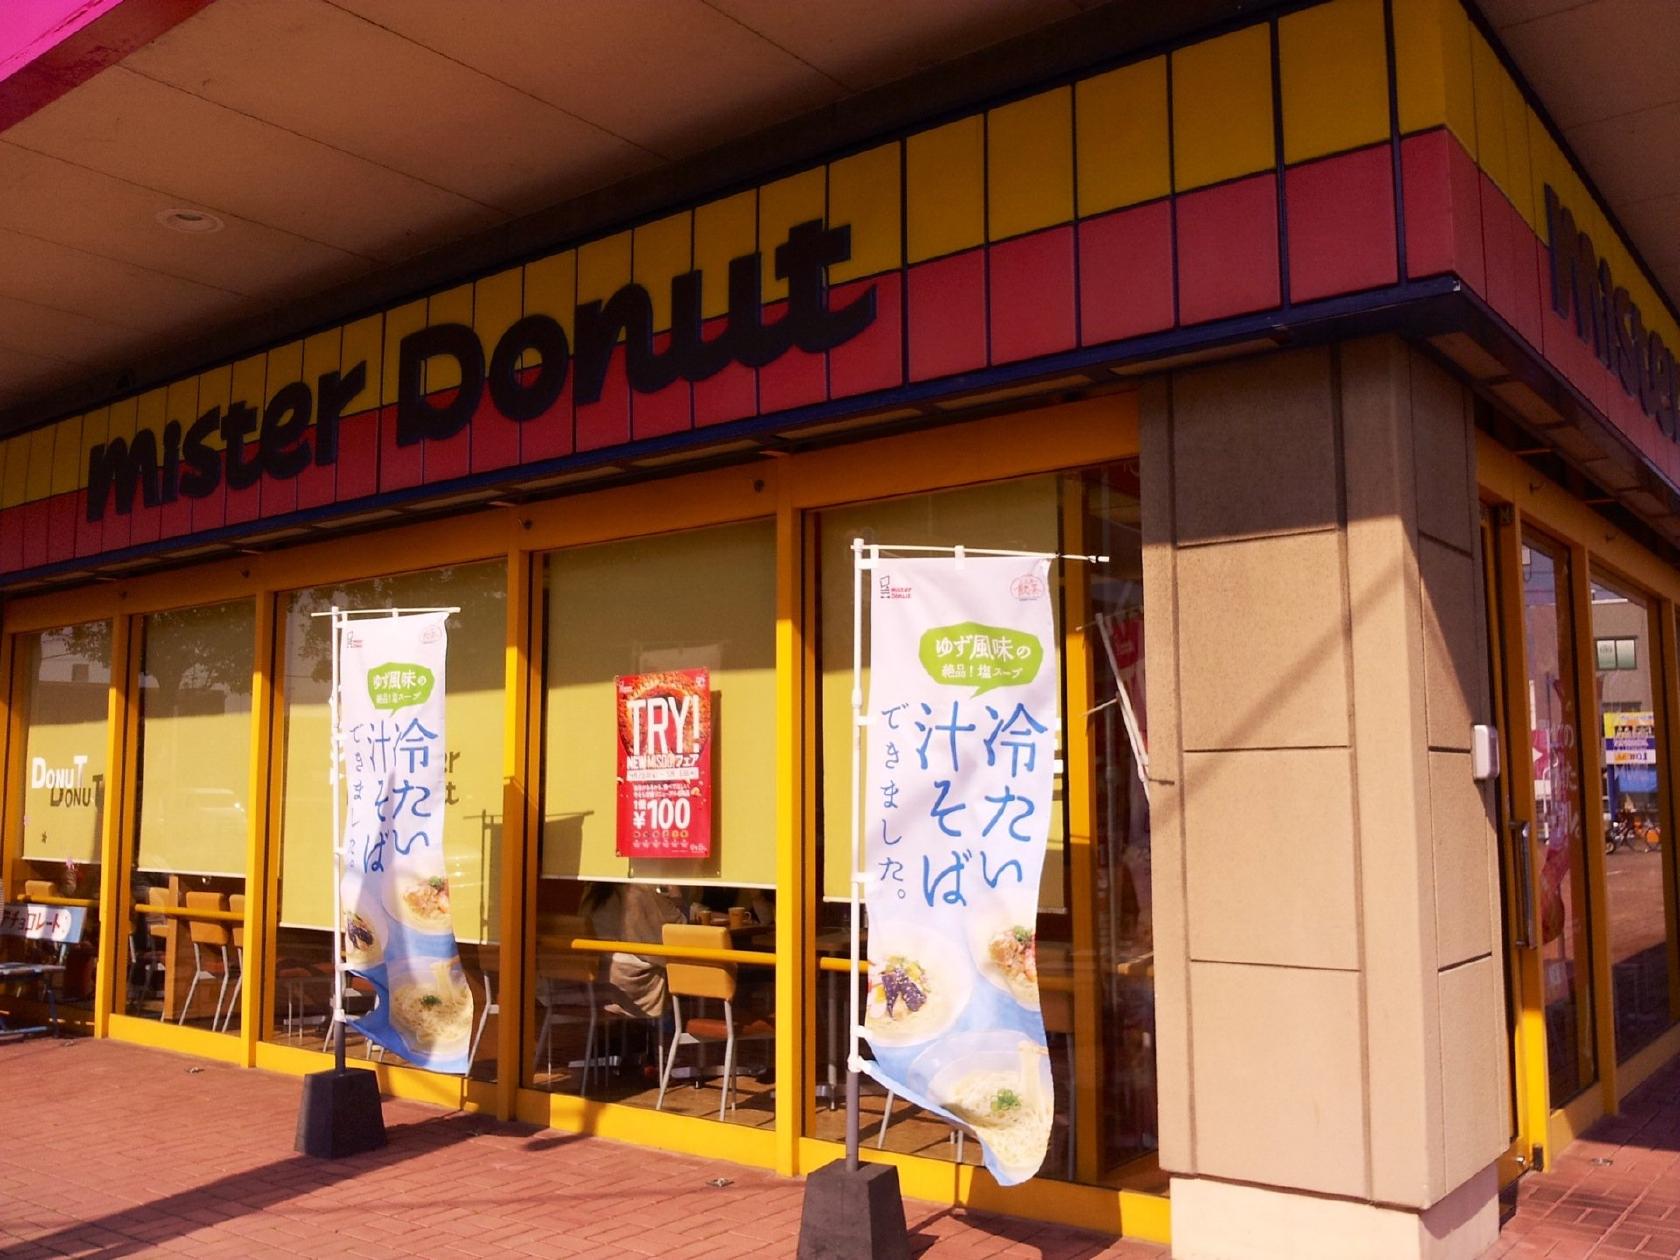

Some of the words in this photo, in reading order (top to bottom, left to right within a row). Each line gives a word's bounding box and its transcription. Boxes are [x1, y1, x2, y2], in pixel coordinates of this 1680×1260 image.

[397, 218, 877, 447] Donut
[373, 669, 427, 690] ゆず風味の
[626, 694, 700, 756] TRY!
[936, 634, 1031, 662] ゆず風味の
[363, 720, 391, 875] 汁そば
[392, 717, 439, 856] 冷たい
[879, 702, 909, 899] できました。
[914, 700, 976, 907] 汁そば
[981, 702, 1048, 888] 冷たい
